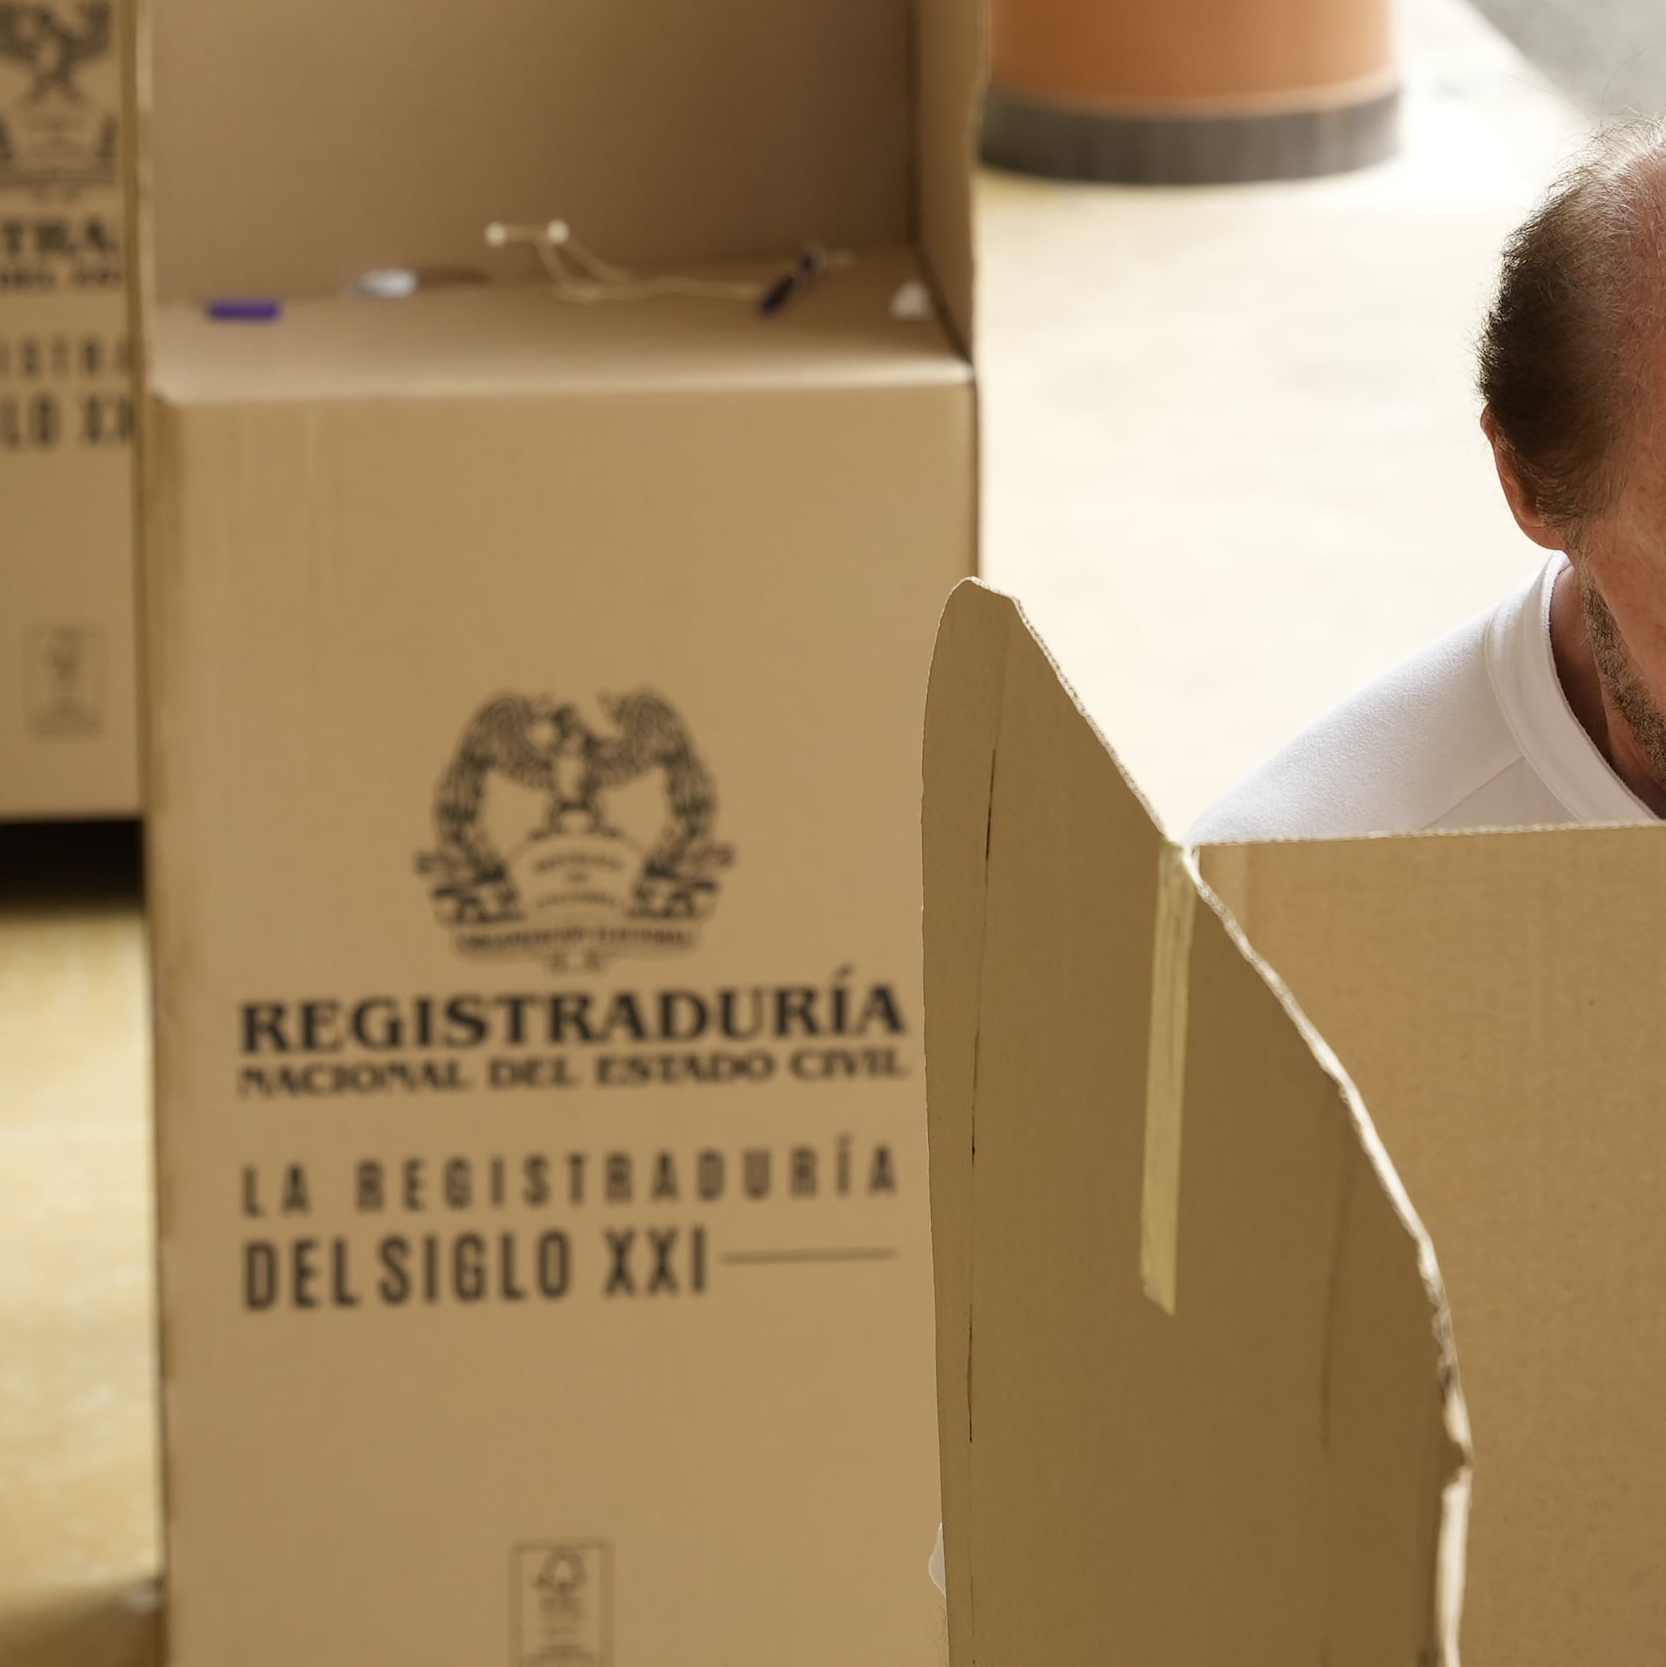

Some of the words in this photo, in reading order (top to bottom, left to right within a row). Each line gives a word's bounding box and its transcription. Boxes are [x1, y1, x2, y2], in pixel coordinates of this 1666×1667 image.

[240, 966, 906, 1054] REGISTRADURÍA
[238, 1059, 470, 1098] NACIONAL
[488, 1055, 579, 1091] DEL
[595, 1050, 775, 1086] ESTADO
[788, 1045, 909, 1082] CIVIL
[242, 1162, 311, 1218] LA
[356, 1134, 897, 1212] REGISTRADURÍA
[244, 1234, 359, 1311] DEL
[377, 1228, 571, 1306] SIGLO
[603, 1223, 707, 1297] XXI
